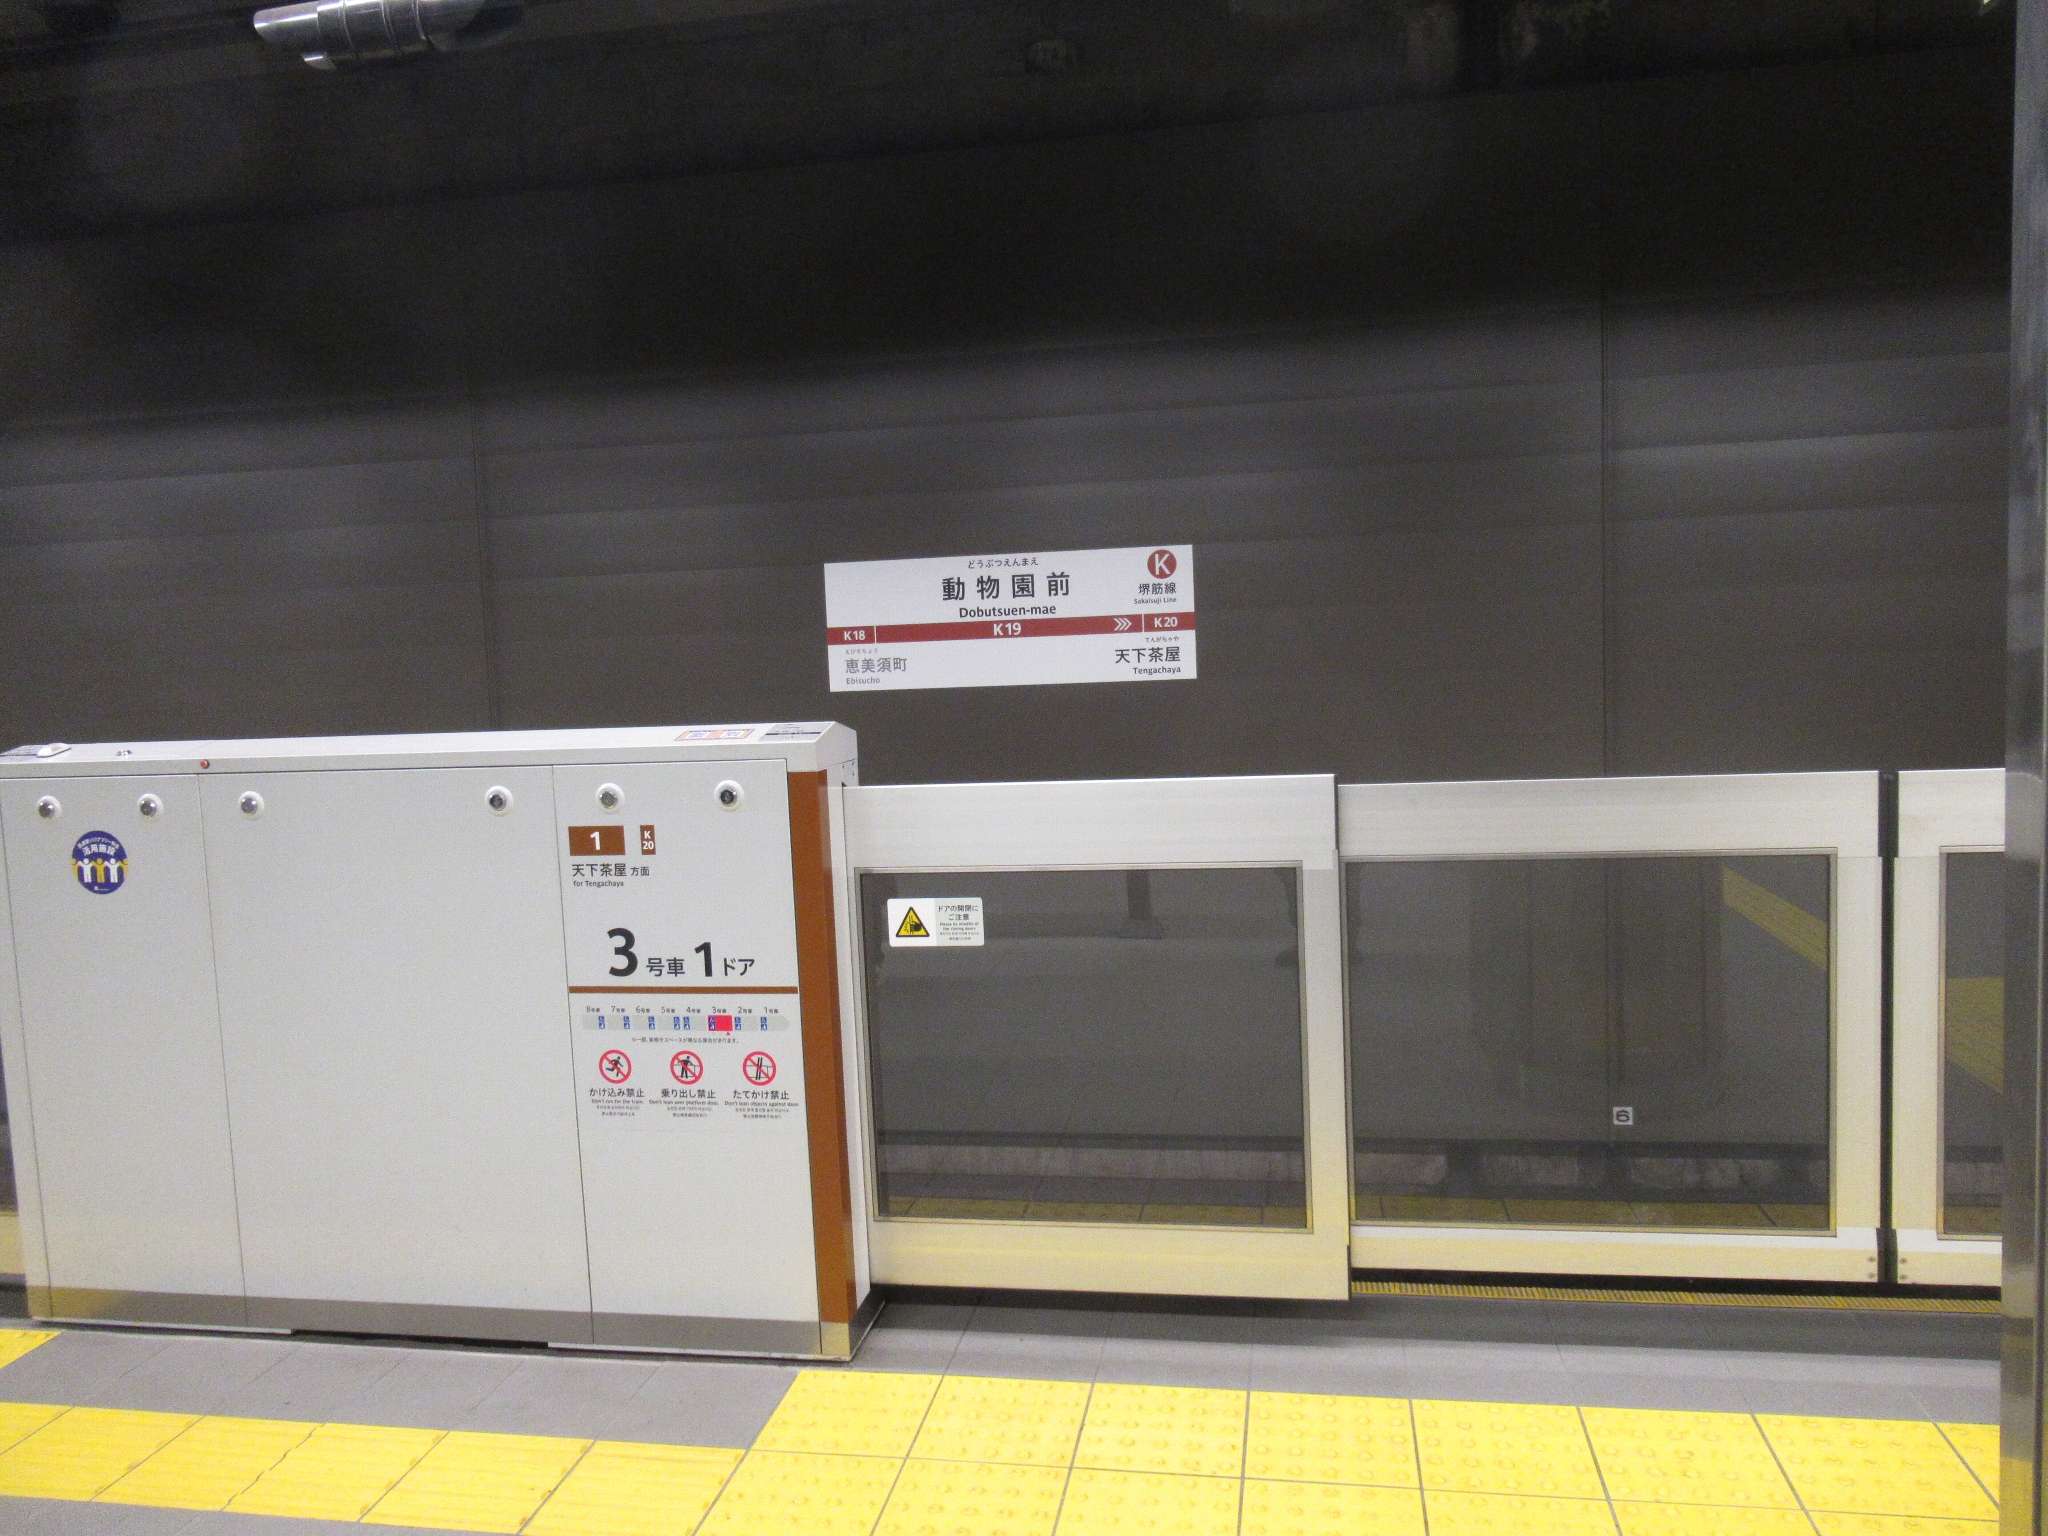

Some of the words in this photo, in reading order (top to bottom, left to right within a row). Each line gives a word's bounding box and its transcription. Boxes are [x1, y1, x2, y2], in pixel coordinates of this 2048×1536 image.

[967, 556, 1039, 569] どうぶつえんまえ
[1154, 553, 1171, 576] K
[941, 571, 1071, 601] 動物園前
[1138, 582, 1177, 596] 堺筋線
[959, 604, 1056, 618] Dobutsuen-mae
[1154, 616, 1178, 628] K20
[843, 630, 866, 641] K18
[993, 622, 1022, 636] K19
[1114, 646, 1181, 664] 天下茶屋
[845, 657, 908, 674] 恵美須町
[1133, 666, 1182, 676] Tengachaya
[846, 676, 880, 685] Ebisucho
[590, 831, 601, 851] 1
[644, 830, 652, 840] K
[642, 840, 654, 850] 20
[571, 862, 627, 878] 天下茶屋
[630, 866, 650, 877] 方面
[585, 880, 624, 888] Tengachaya
[589, 1087, 645, 1098] かけ込み禁止
[661, 1088, 717, 1099] 乗り出し禁止
[733, 1090, 790, 1100] たてかけ禁止
[1616, 1109, 1630, 1122] 6
